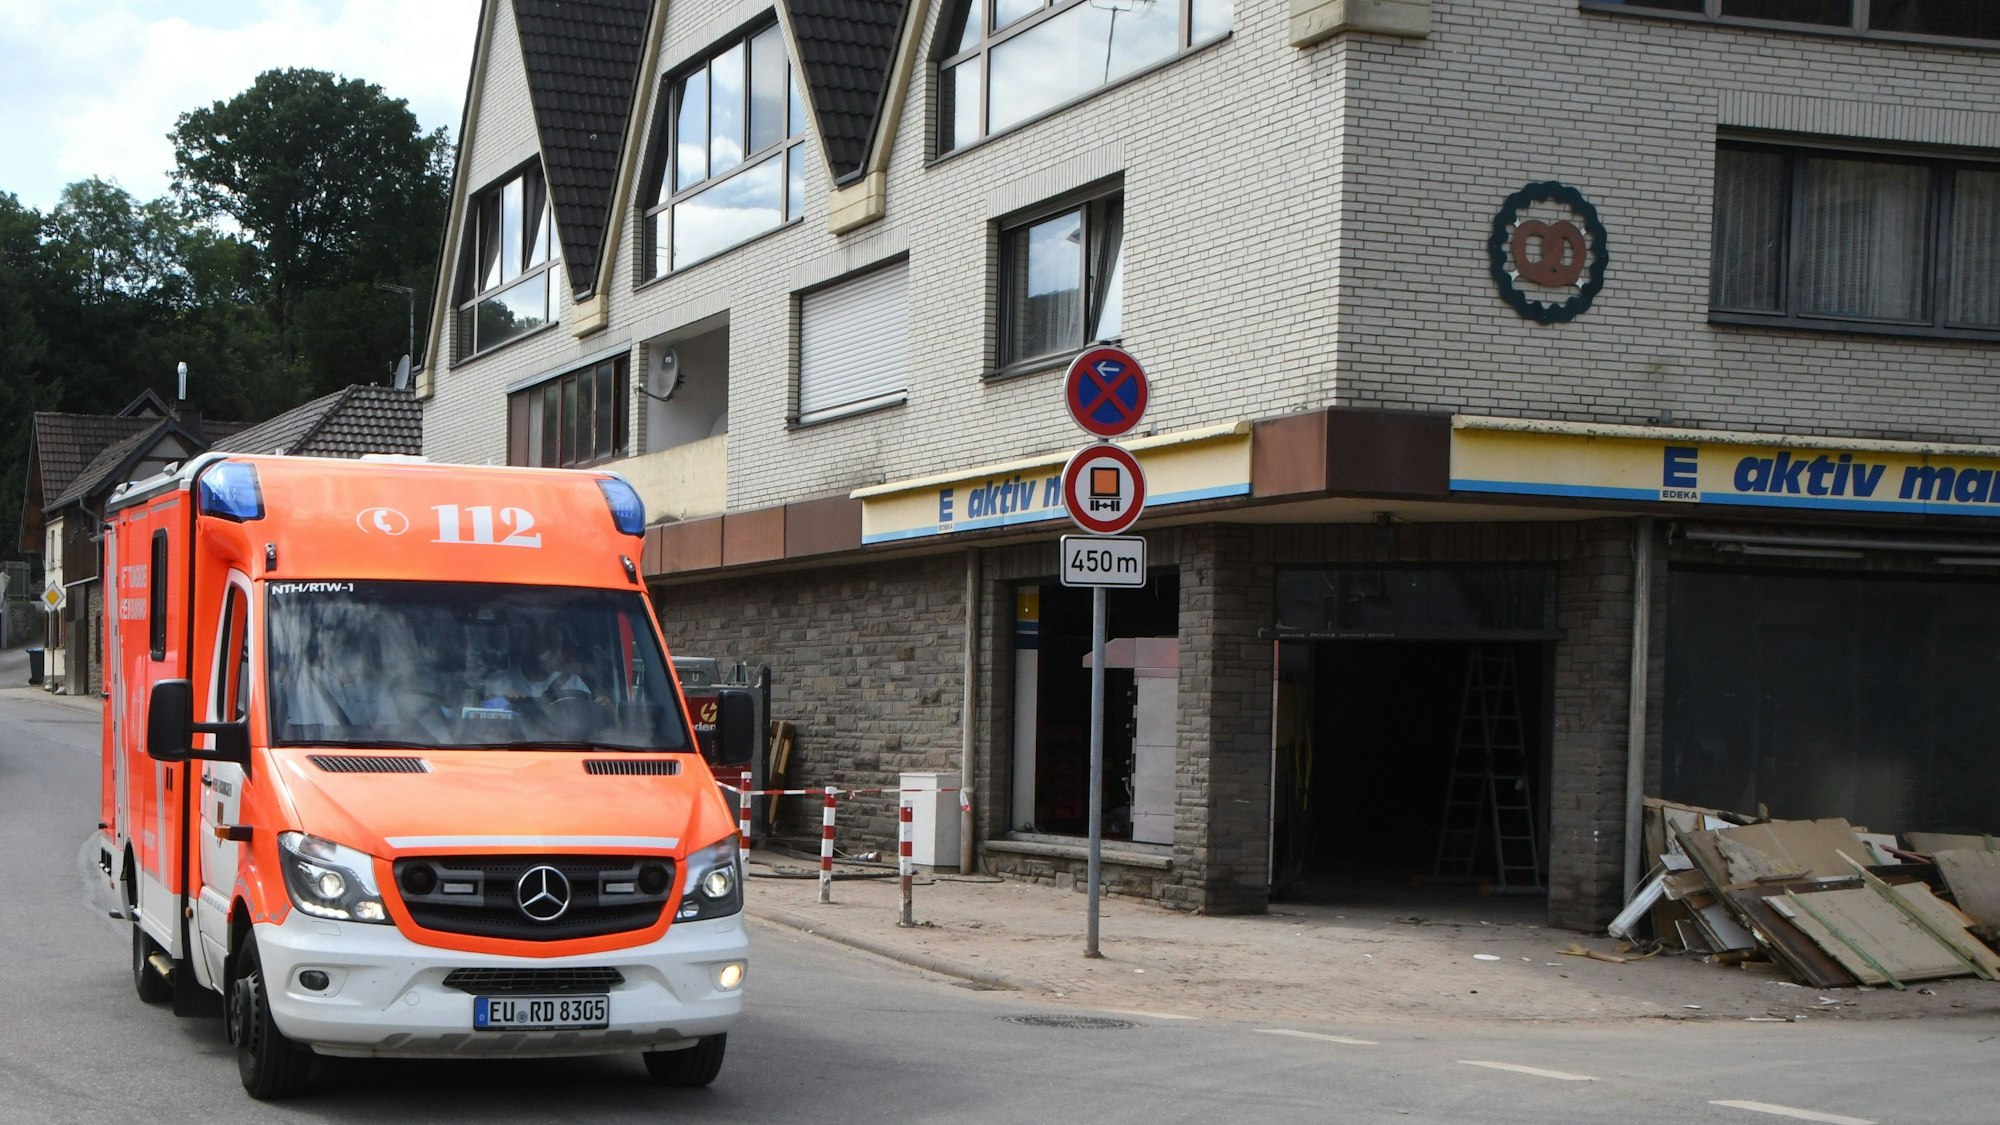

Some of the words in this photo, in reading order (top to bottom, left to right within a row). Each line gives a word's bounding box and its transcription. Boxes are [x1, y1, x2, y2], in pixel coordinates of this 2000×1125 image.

[1663, 446, 1698, 488] E
[1734, 451, 1886, 497] aktiv
[939, 488, 953, 522] E
[968, 475, 1036, 518] aktiv
[1662, 490, 1697, 499] EDEKA
[430, 504, 542, 548] 112
[1071, 550, 1112, 572] 450
[1117, 557, 1137, 573] m
[271, 583, 354, 595] NTH/RTW-1
[490, 1001, 515, 1022] EU
[530, 1001, 554, 1022] RD
[560, 1000, 605, 1021] 8305
